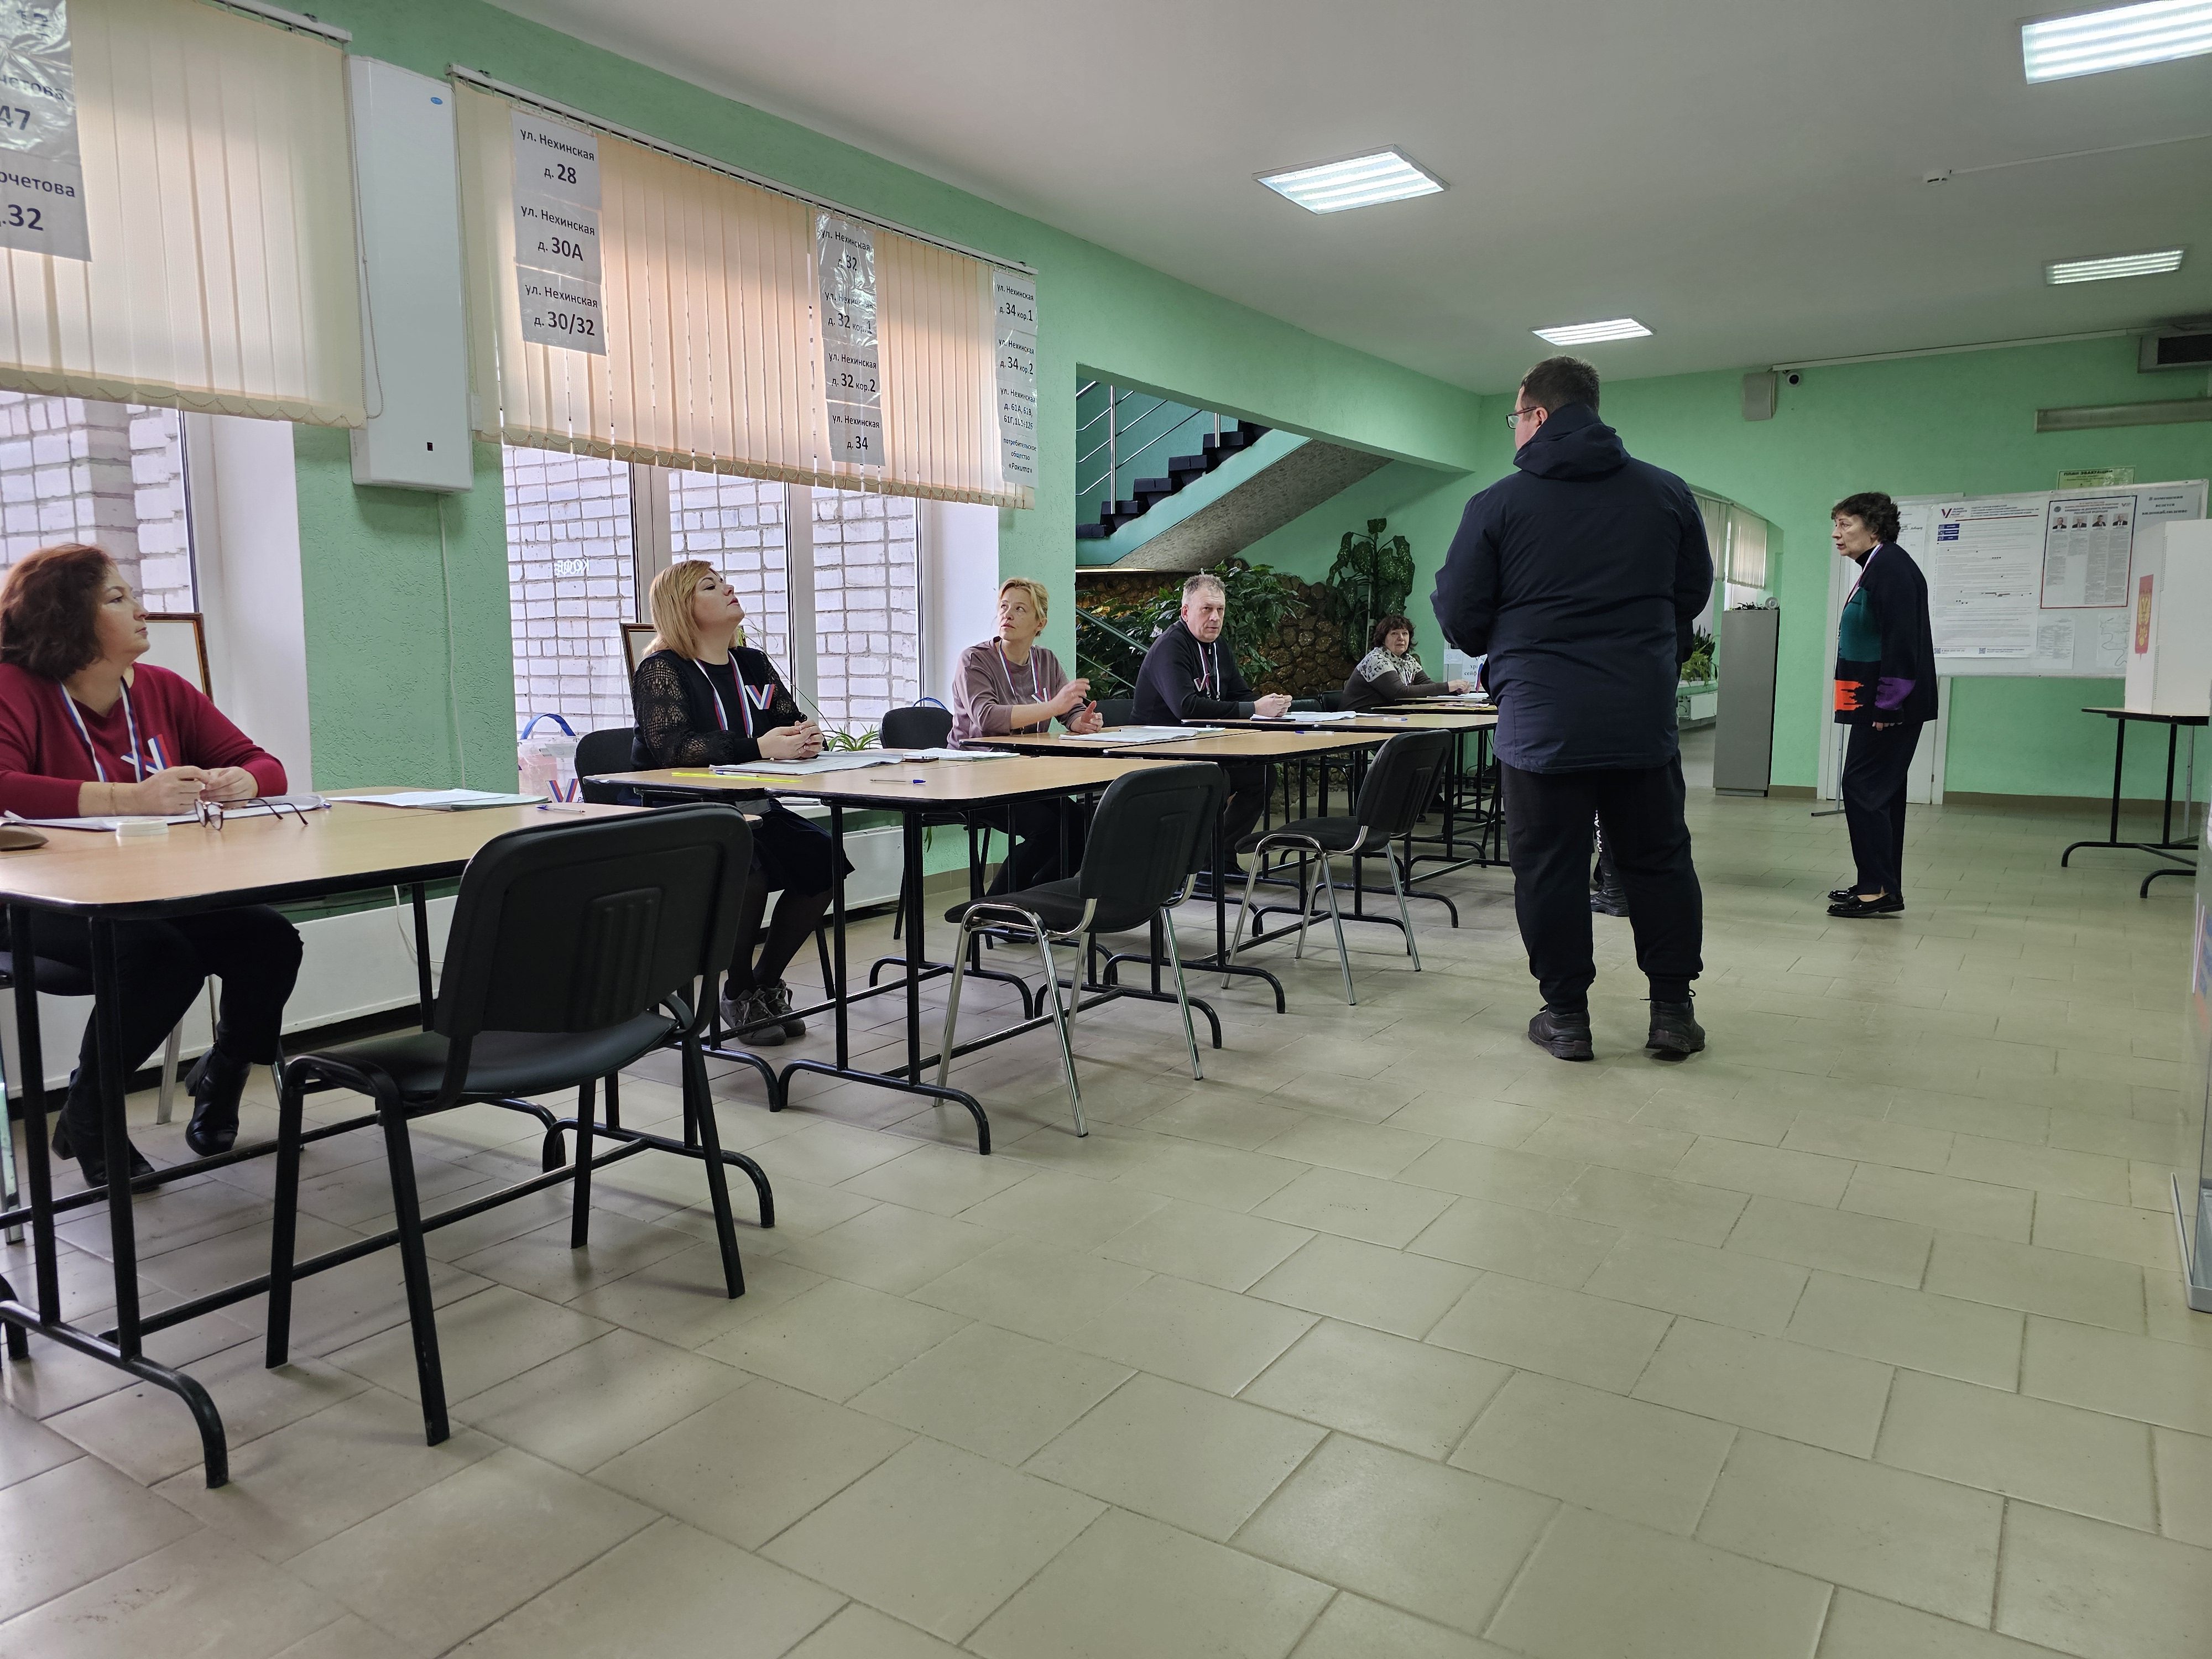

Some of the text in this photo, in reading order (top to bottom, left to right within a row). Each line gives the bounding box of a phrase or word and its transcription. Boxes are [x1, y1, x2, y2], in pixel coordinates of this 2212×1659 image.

[520, 129, 594, 161] ул. Нехинская
[544, 164, 577, 184] д. 28
[0, 171, 75, 198] очетова
[521, 206, 595, 236] ул. Нехинская
[822, 230, 870, 251] ул. Нехинская
[538, 237, 583, 262] д. 30А
[846, 254, 857, 271] 32
[525, 284, 598, 308] ул. Нехинская
[825, 292, 836, 301] ул.
[1006, 285, 1034, 301] Нехинская
[1006, 302, 1016, 316] 34
[534, 311, 595, 336] д. 30/32
[828, 317, 836, 326] д.
[837, 313, 851, 328] 32
[1008, 339, 1035, 354] Нехинская
[828, 353, 877, 369] ул. Нехинская
[1008, 356, 1019, 370] 34
[831, 378, 839, 387] д.
[841, 373, 854, 388] 32
[1000, 387, 1035, 403] ул. Нехинская
[832, 415, 880, 428] ул. Нехинская
[847, 436, 868, 450] д. 34
[1003, 438, 1037, 451] потребительское
[1011, 451, 1030, 460] общество
